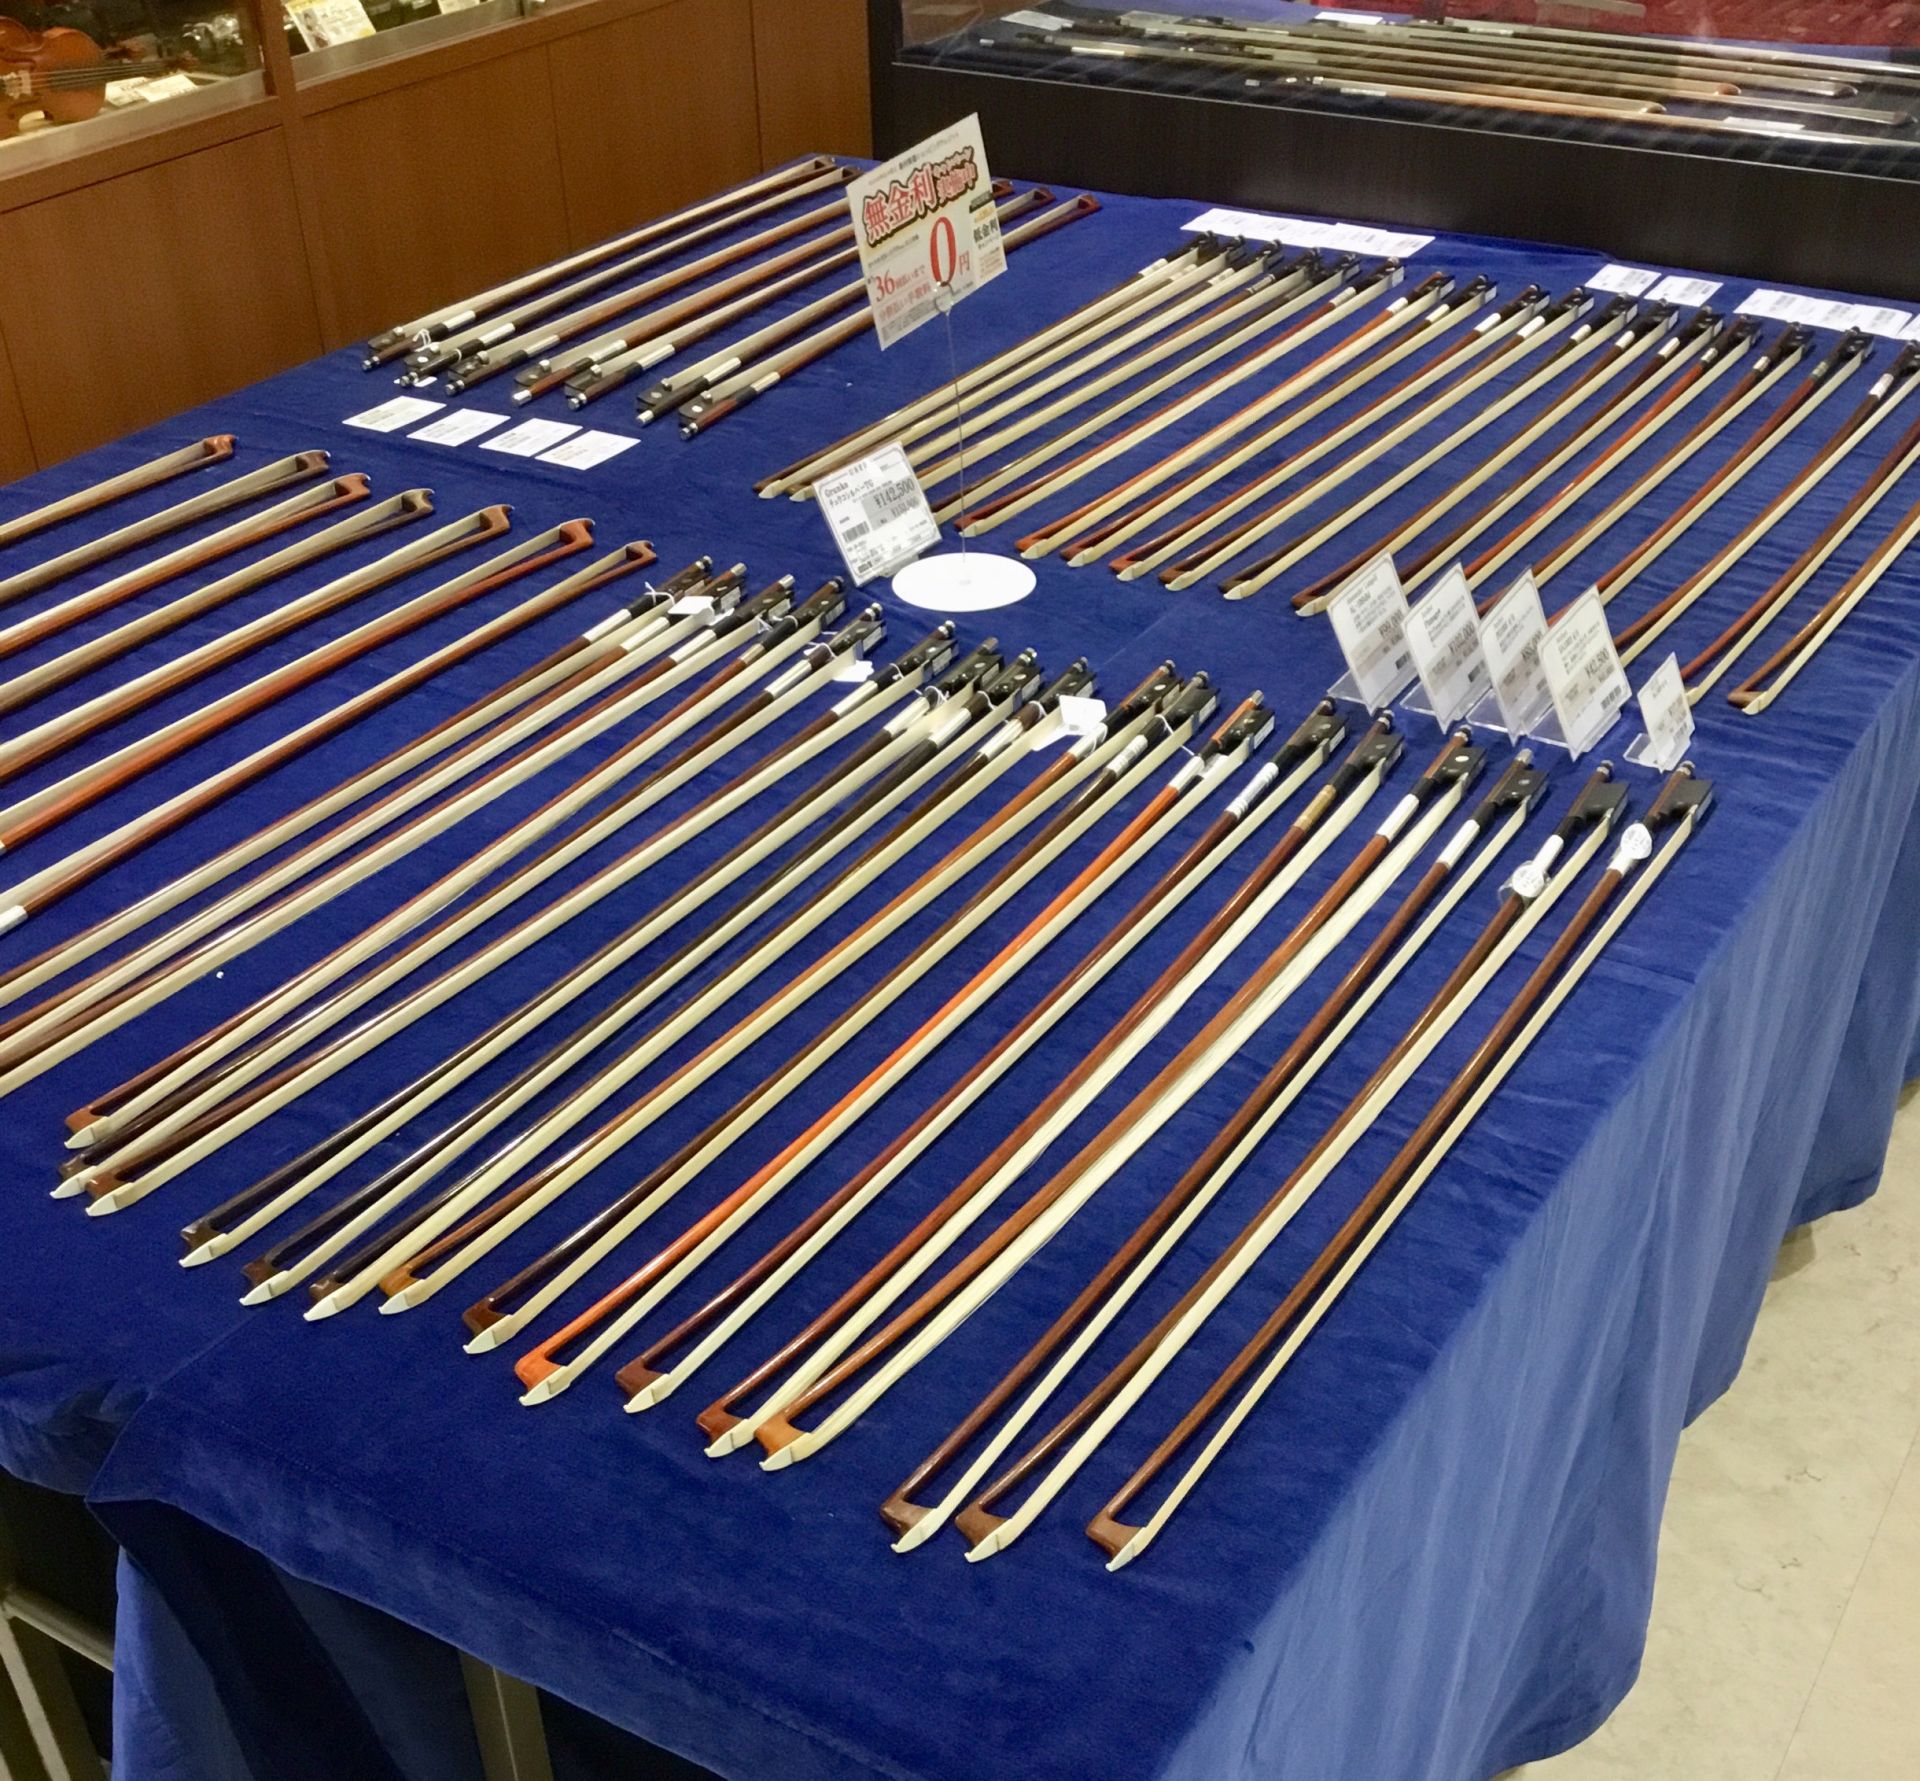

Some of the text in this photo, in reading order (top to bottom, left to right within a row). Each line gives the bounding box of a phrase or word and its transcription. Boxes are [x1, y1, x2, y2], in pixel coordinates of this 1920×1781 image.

[864, 165, 937, 244] 無金利
[874, 478, 915, 509] ¥142,500
